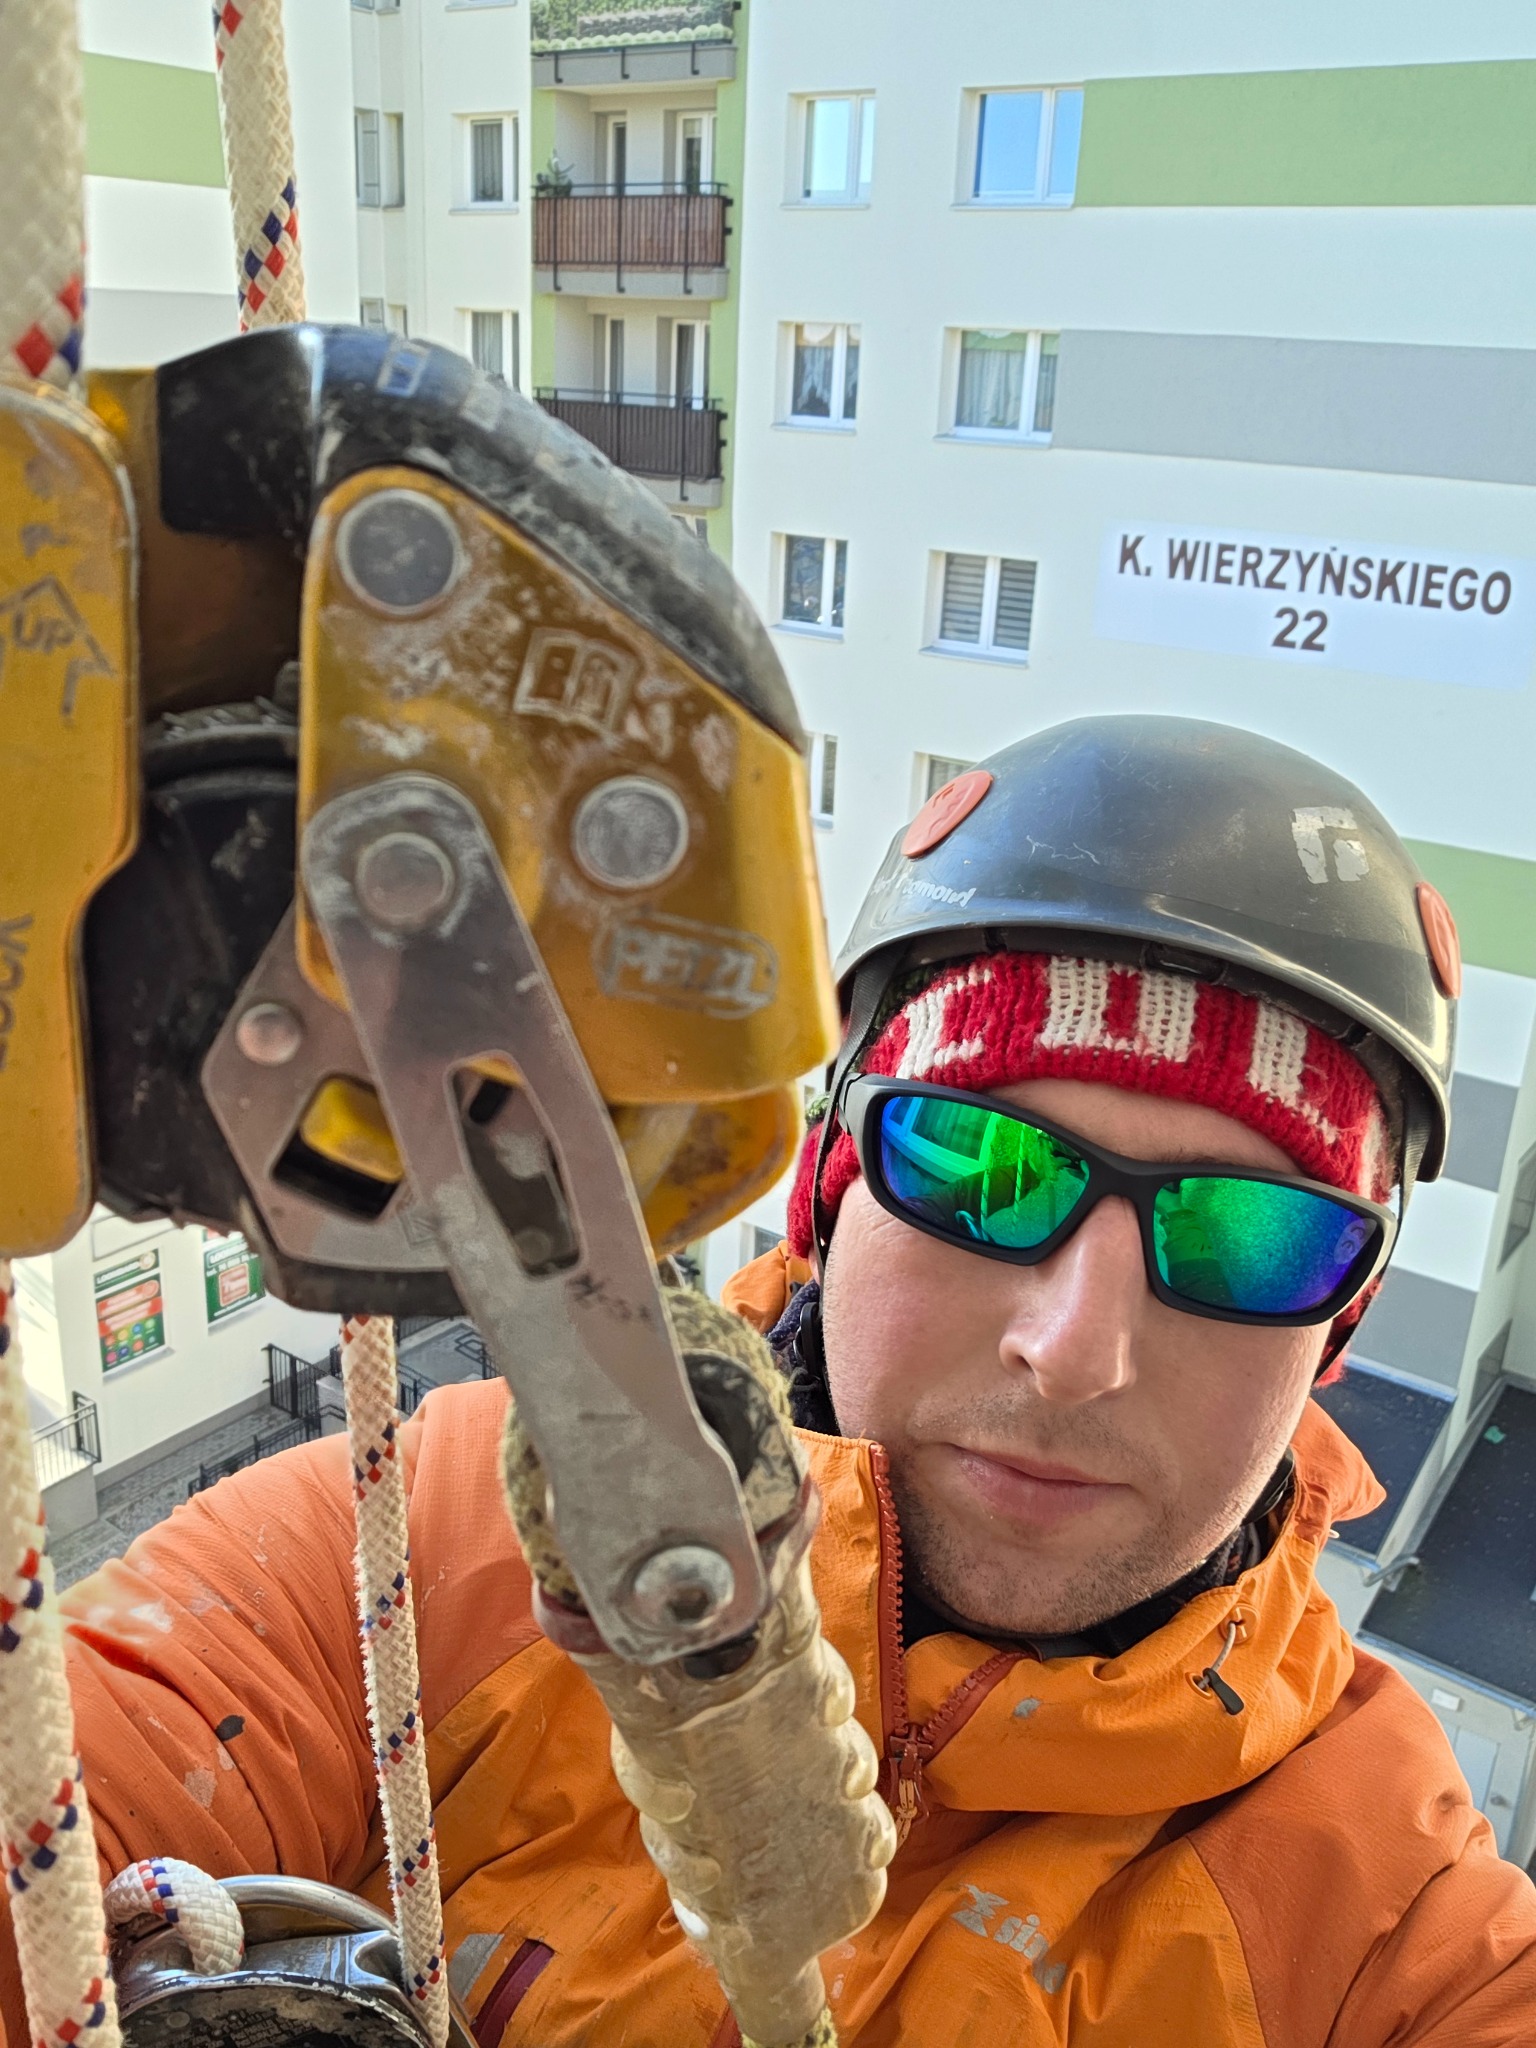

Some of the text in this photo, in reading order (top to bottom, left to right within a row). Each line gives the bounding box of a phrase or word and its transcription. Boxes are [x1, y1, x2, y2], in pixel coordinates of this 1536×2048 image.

[1117, 533, 1512, 616] K. WIERZYŃSKIEGO
[13, 606, 76, 655] UP
[1271, 607, 1329, 652] 22
